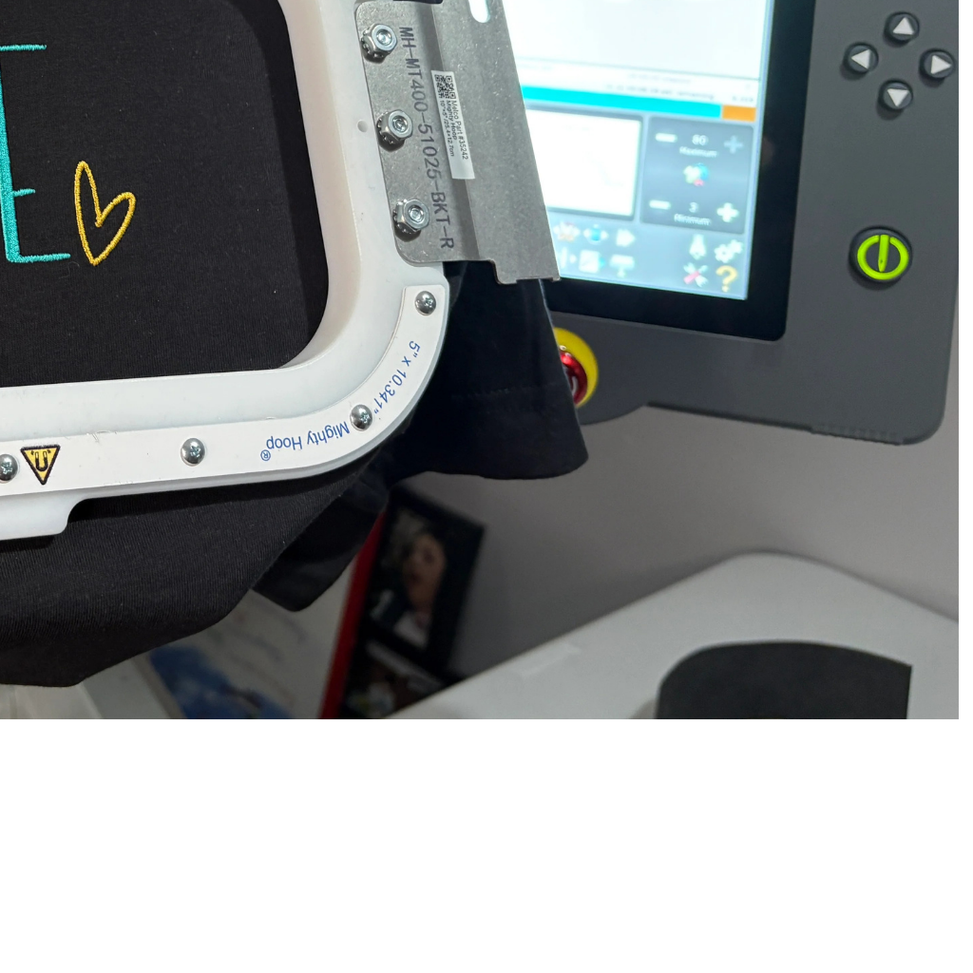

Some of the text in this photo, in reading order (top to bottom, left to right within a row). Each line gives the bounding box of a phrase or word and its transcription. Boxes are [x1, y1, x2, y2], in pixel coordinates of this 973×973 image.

[446, 100, 454, 122] Mighty
[399, 27, 455, 249] MH-MT400-51025-BKT-R
[451, 100, 459, 120] Melco
[458, 135, 469, 160] #35242
[401, 355, 412, 367] x
[307, 421, 351, 446] Mighty
